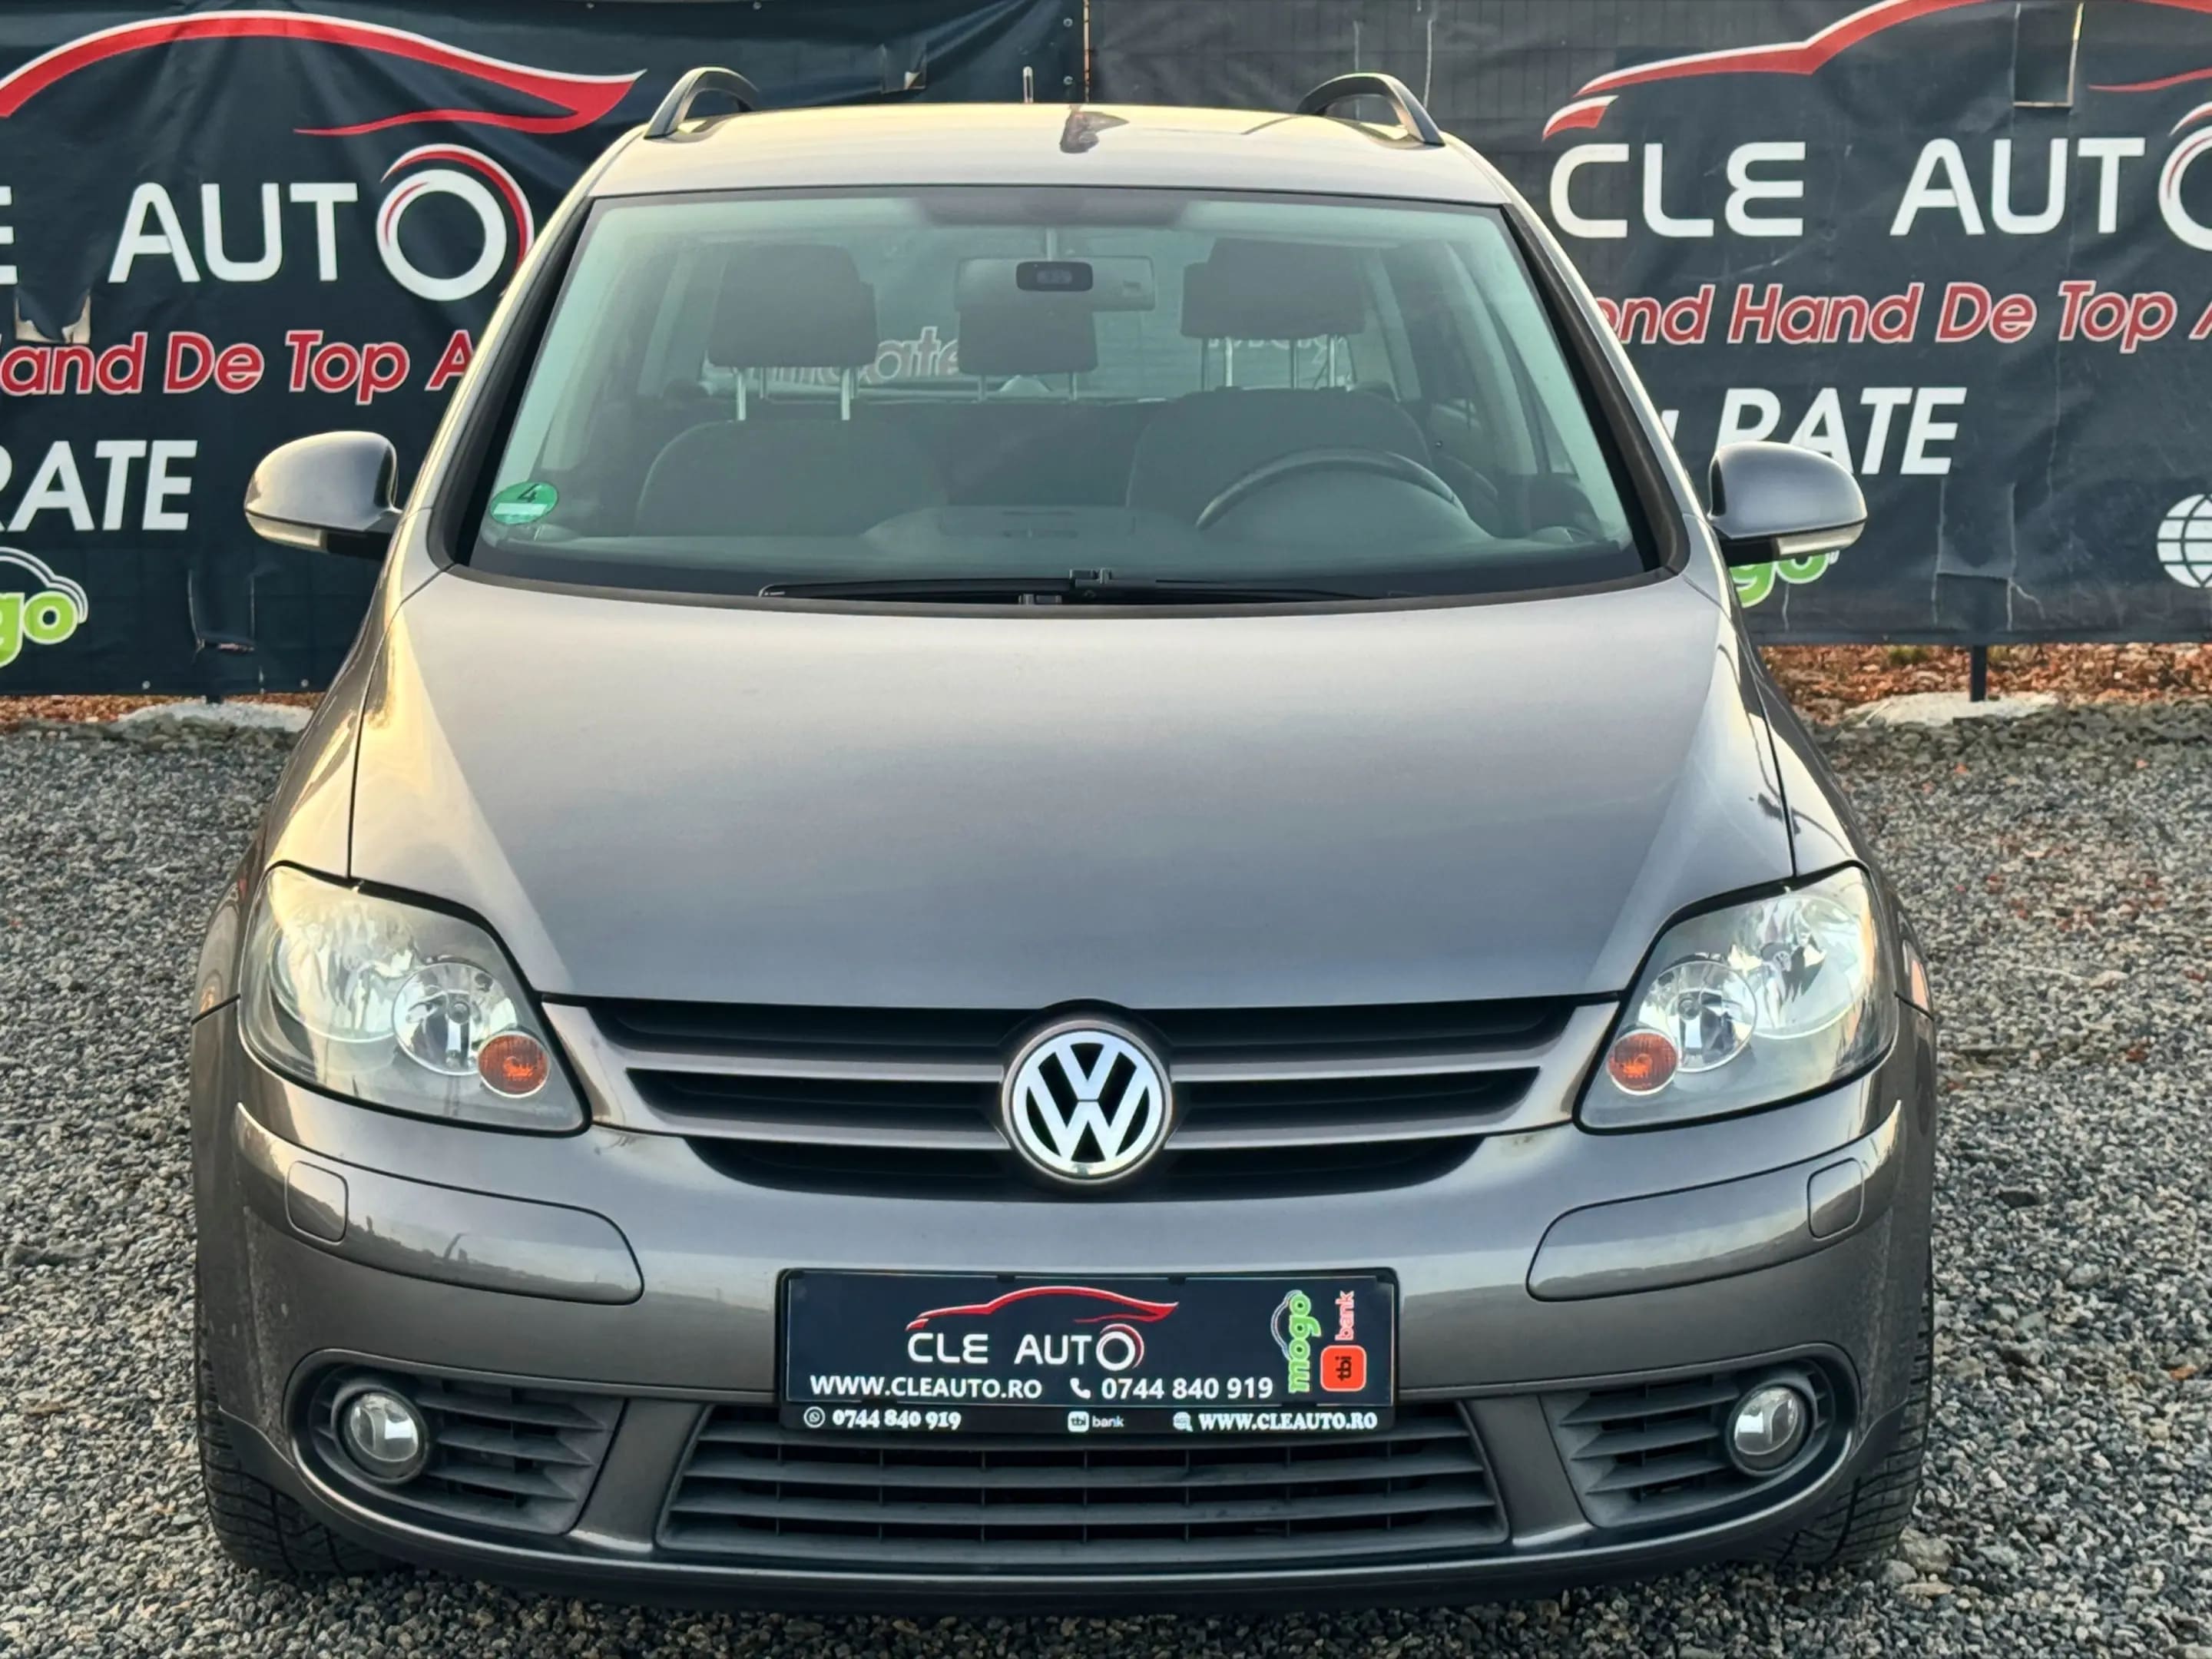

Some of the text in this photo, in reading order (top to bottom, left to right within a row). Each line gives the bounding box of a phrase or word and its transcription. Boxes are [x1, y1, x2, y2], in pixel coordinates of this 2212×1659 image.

[1550, 141, 1806, 238] CLE
[108, 169, 508, 301] AUTO
[1727, 283, 1925, 345] Hand
[1936, 282, 2037, 343] De
[2058, 280, 2178, 354] Top
[0, 331, 148, 395] and
[164, 332, 265, 394] De
[285, 330, 409, 405] Top
[0, 440, 197, 531] ATE
[1334, 1290, 1355, 1341] bank
[907, 1330, 1137, 1372] CLE AUTO
[1288, 1293, 1322, 1393] mogo
[810, 1375, 1043, 1399] WWW.CLEAUTO.RO
[1101, 1377, 1274, 1400] 0744 840 919
[832, 1409, 962, 1431] 0744 840 919
[1091, 1414, 1125, 1429] bank
[1198, 1411, 1378, 1431] WWW.CLEAUTO.RO
